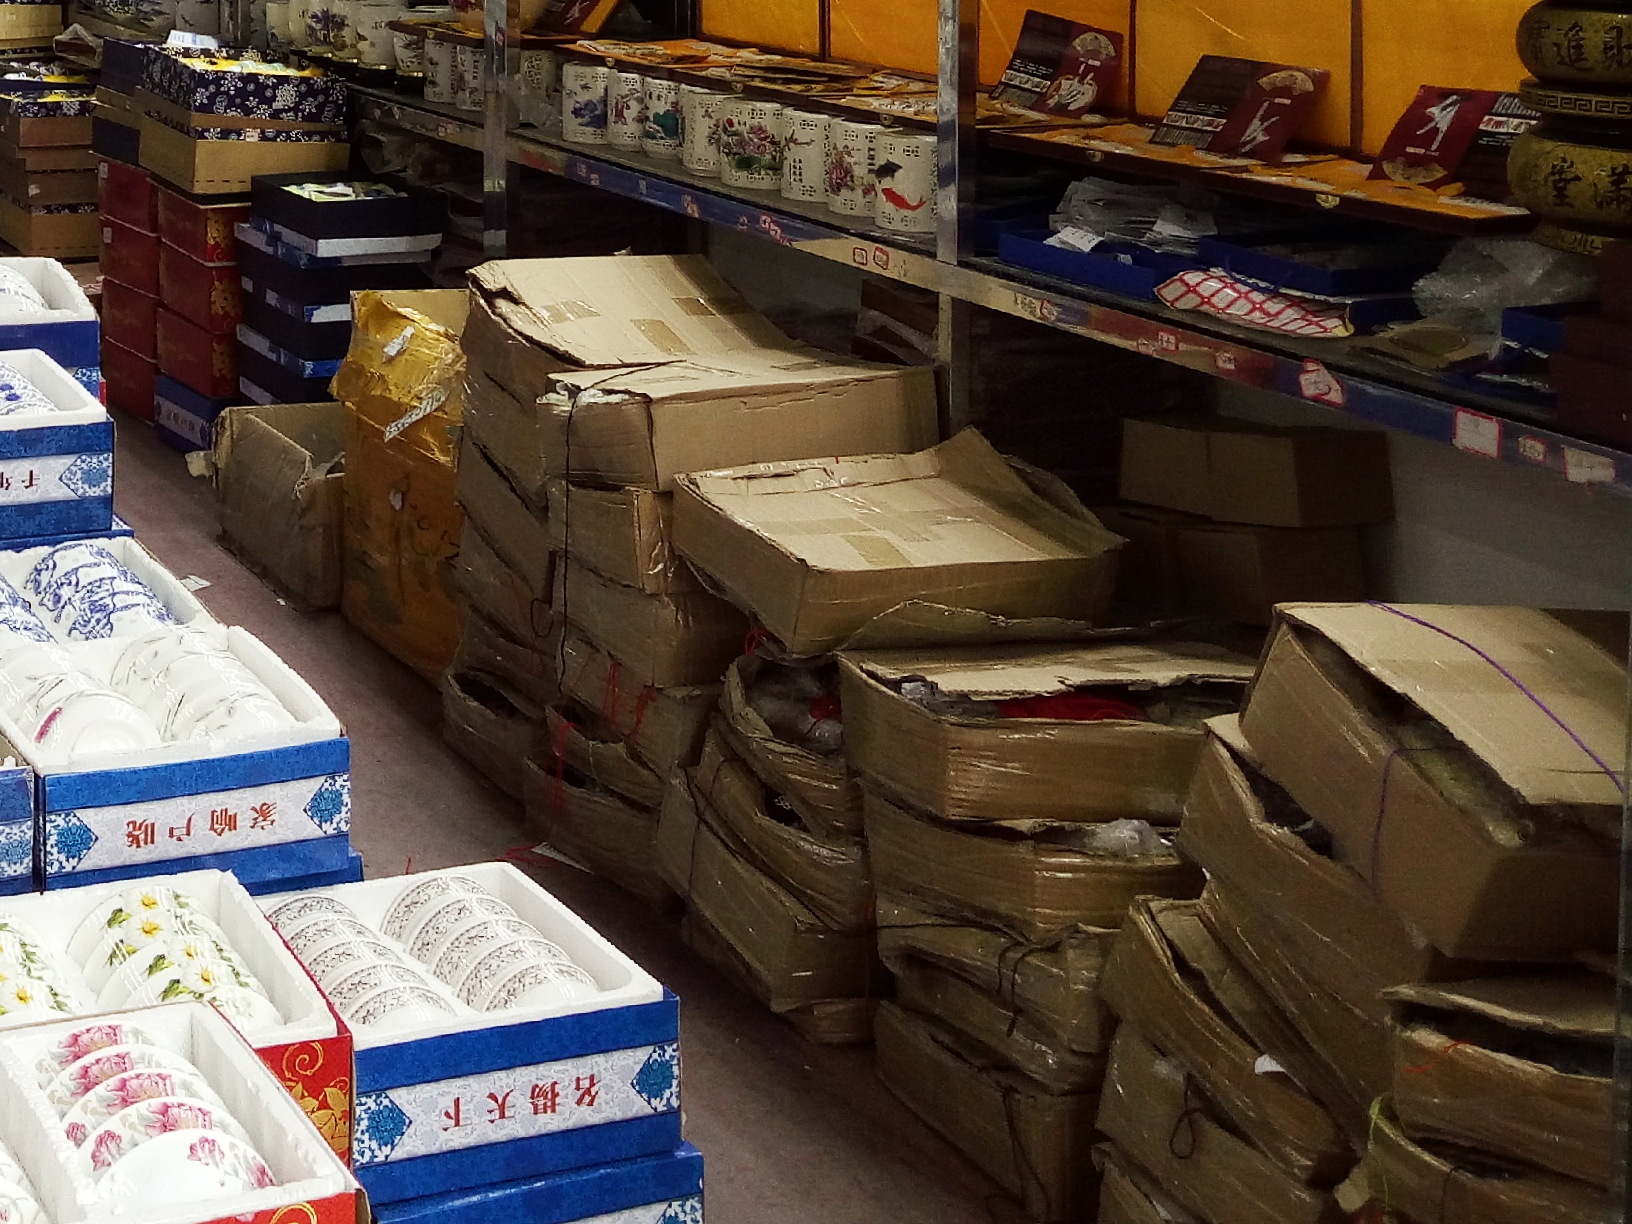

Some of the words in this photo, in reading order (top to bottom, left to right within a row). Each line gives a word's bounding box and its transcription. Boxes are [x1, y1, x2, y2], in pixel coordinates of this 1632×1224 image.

[125, 802, 277, 849] 家喻户晓
[441, 1073, 602, 1132] 名揚天下
